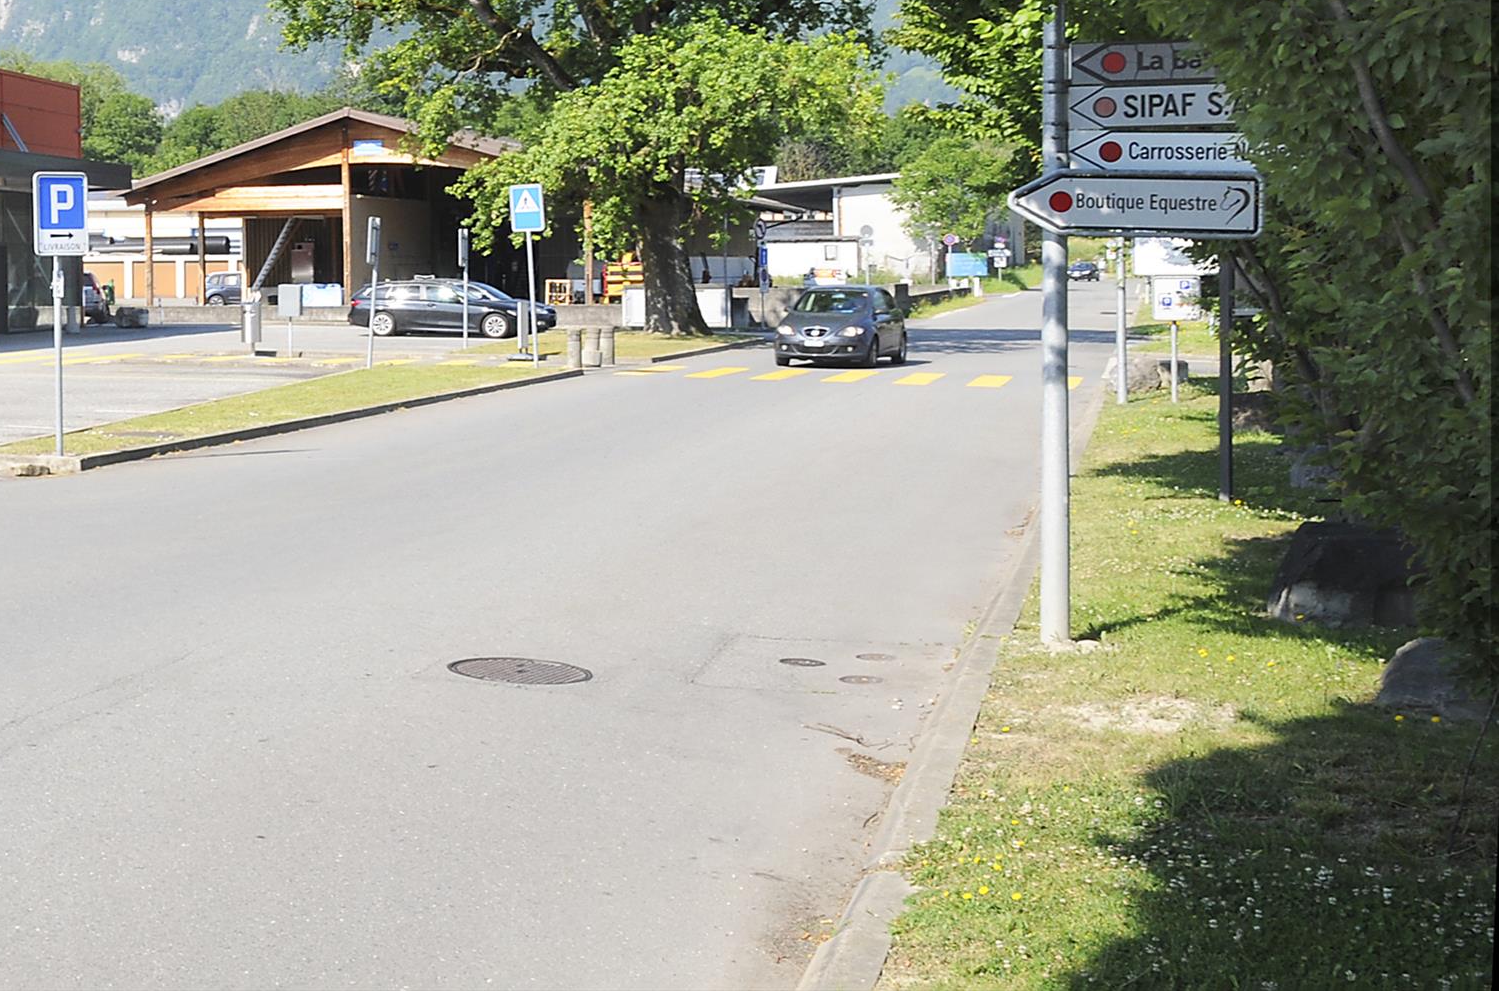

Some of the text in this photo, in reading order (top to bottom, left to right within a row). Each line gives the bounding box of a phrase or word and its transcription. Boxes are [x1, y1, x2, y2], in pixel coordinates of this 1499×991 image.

[1137, 51, 1163, 70] La
[1123, 93, 1196, 118] SIPAF
[1128, 141, 1227, 160] Carrosserie
[49, 183, 75, 225] P
[1075, 192, 1217, 215] Boutique Equestre
